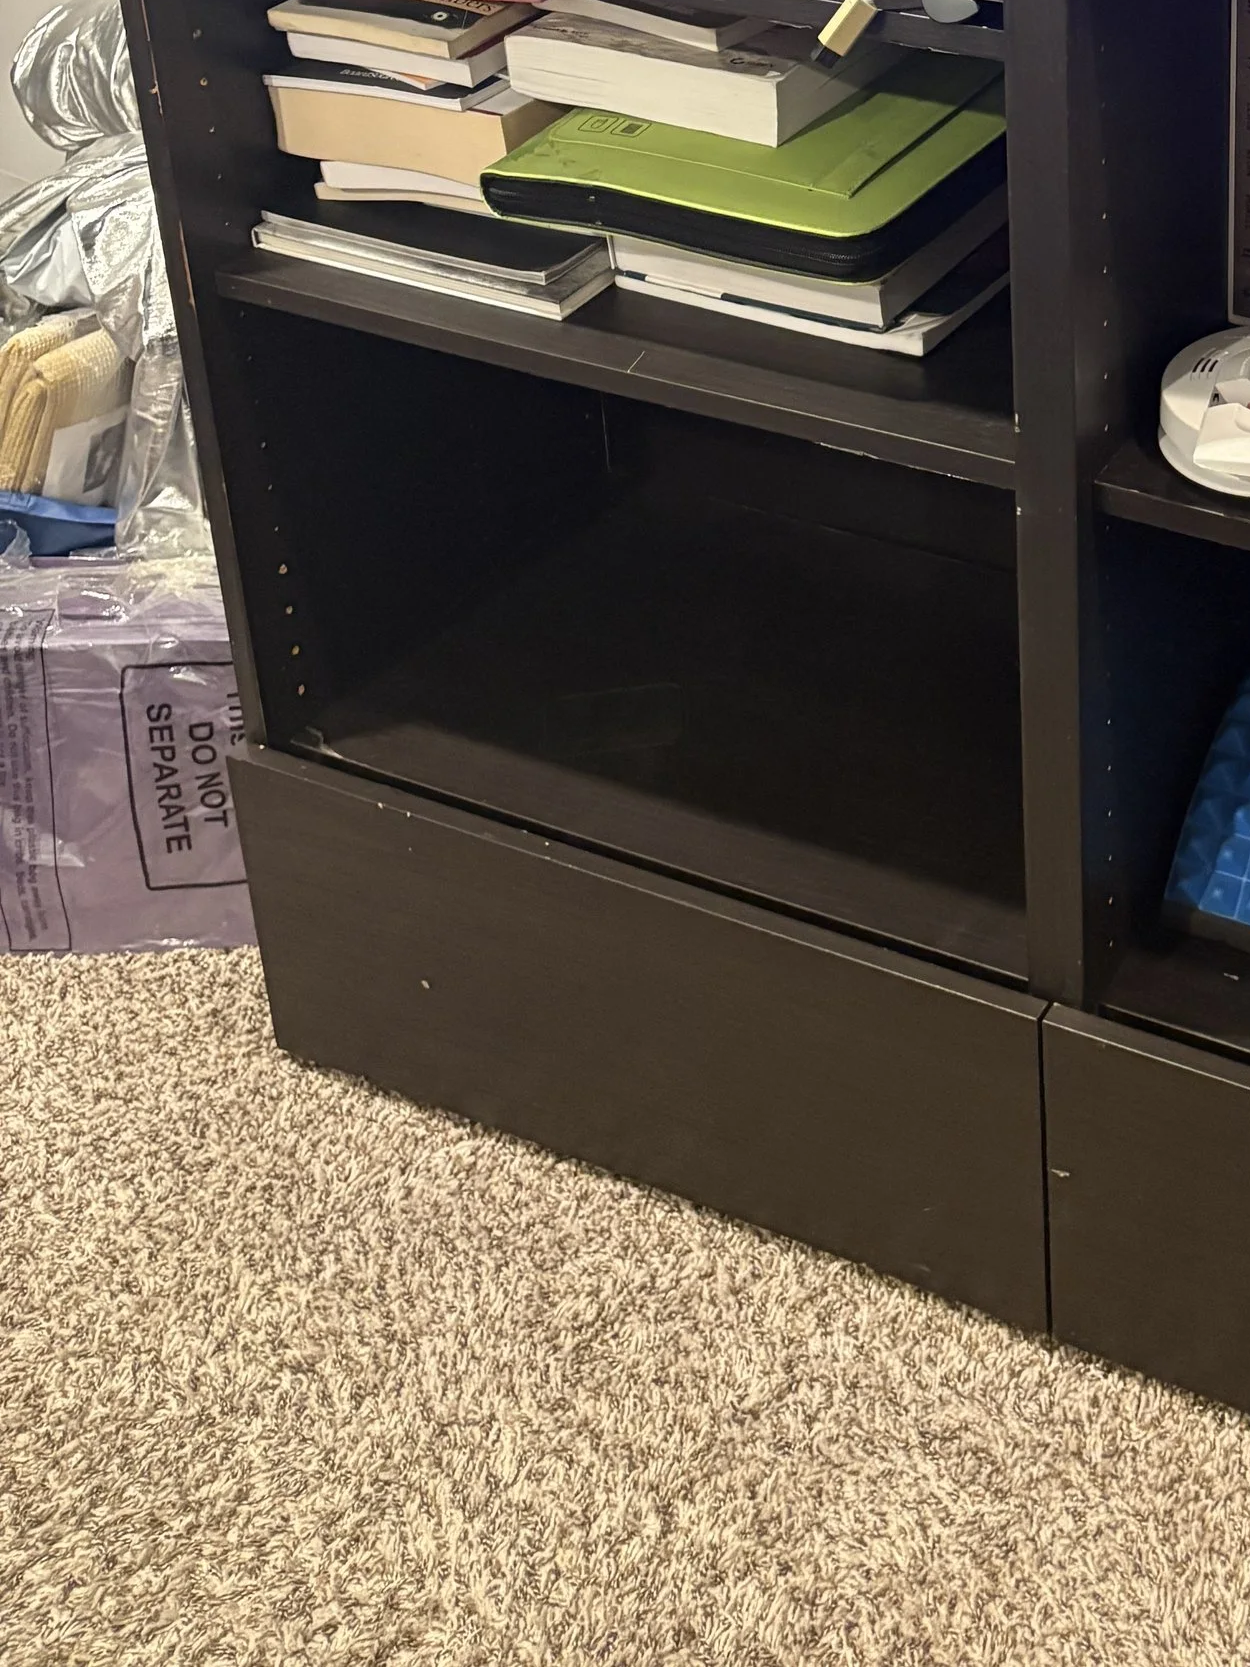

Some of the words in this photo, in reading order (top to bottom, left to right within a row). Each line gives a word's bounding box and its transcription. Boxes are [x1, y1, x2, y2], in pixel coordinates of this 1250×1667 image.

[188, 720, 218, 766] DO
[145, 702, 194, 855] SEPARATE
[195, 771, 230, 829] NOT
